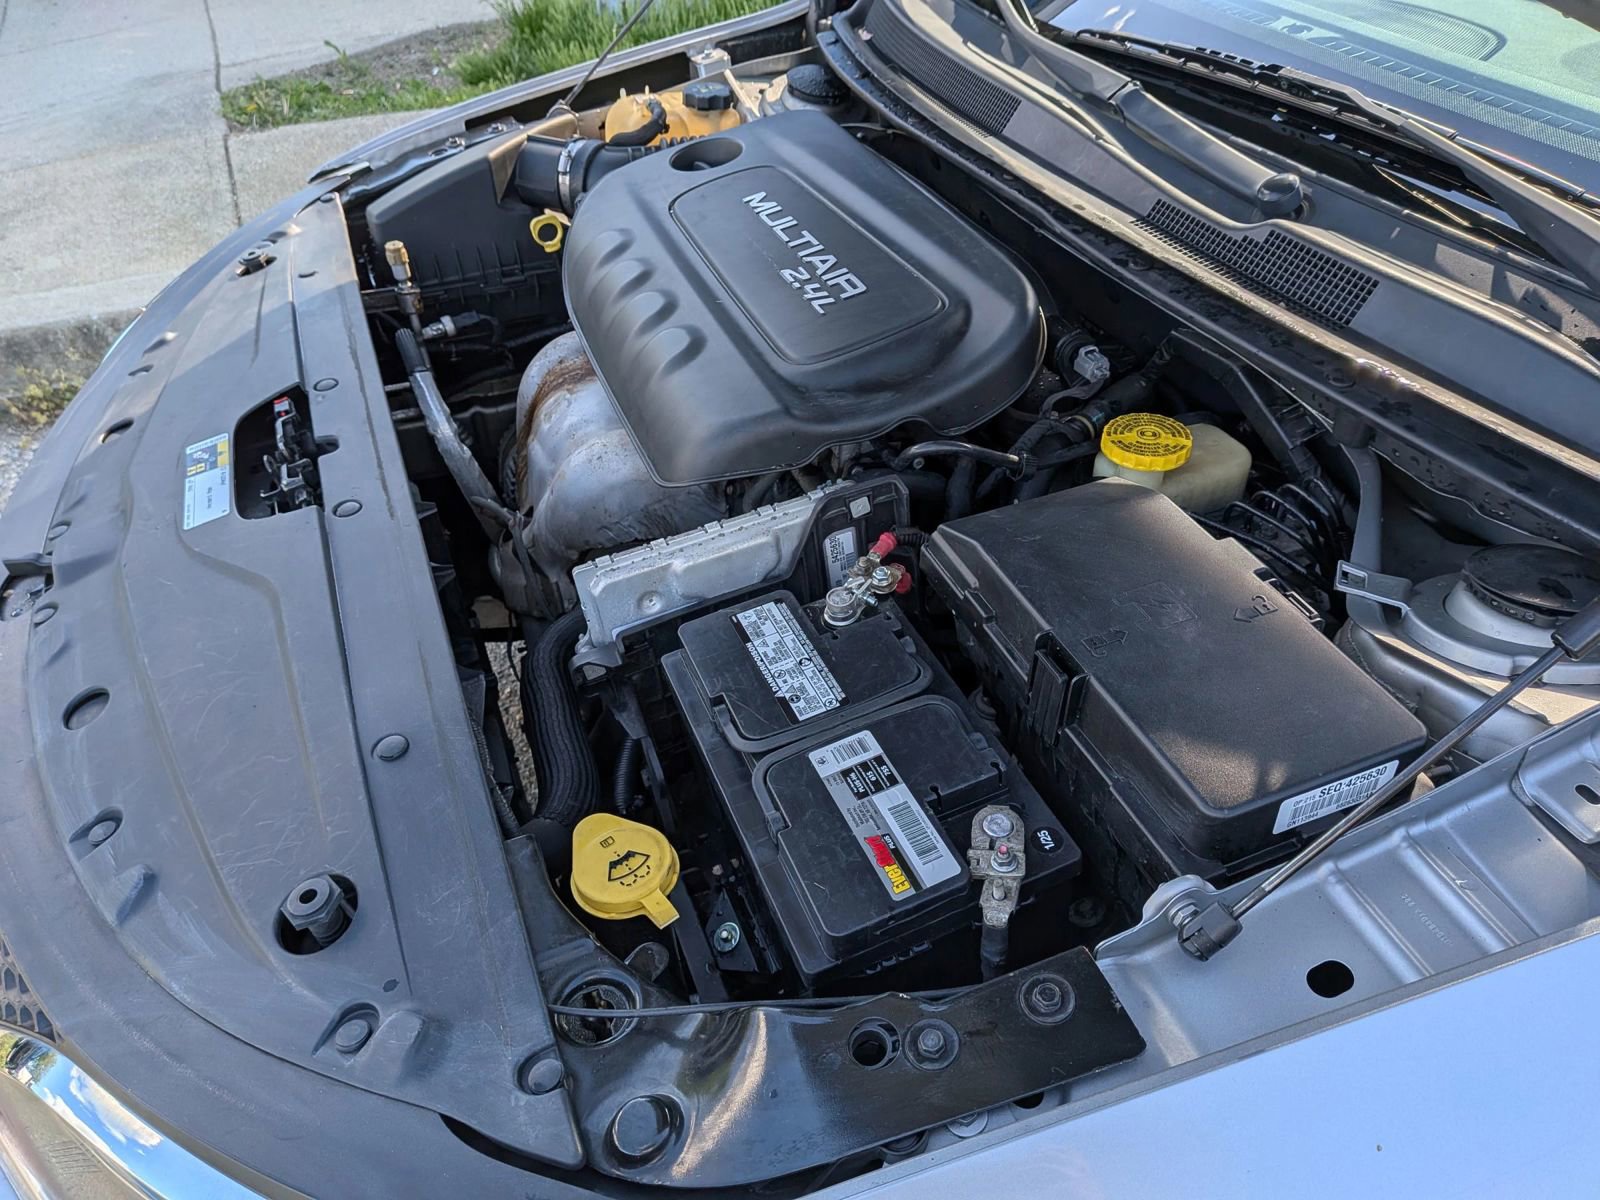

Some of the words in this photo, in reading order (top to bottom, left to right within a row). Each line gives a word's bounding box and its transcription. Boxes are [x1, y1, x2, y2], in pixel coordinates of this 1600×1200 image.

[742, 191, 867, 299] MULTIAIR
[780, 266, 836, 314] 2.4L
[745, 642, 780, 692] DANGER/POISON
[865, 770, 876, 781] 615
[880, 764, 891, 775] 755
[1318, 765, 1388, 798] SEQ:425630
[884, 835, 895, 849] PLUS
[1036, 830, 1055, 850] 1/25
[864, 834, 911, 895] EverStart
